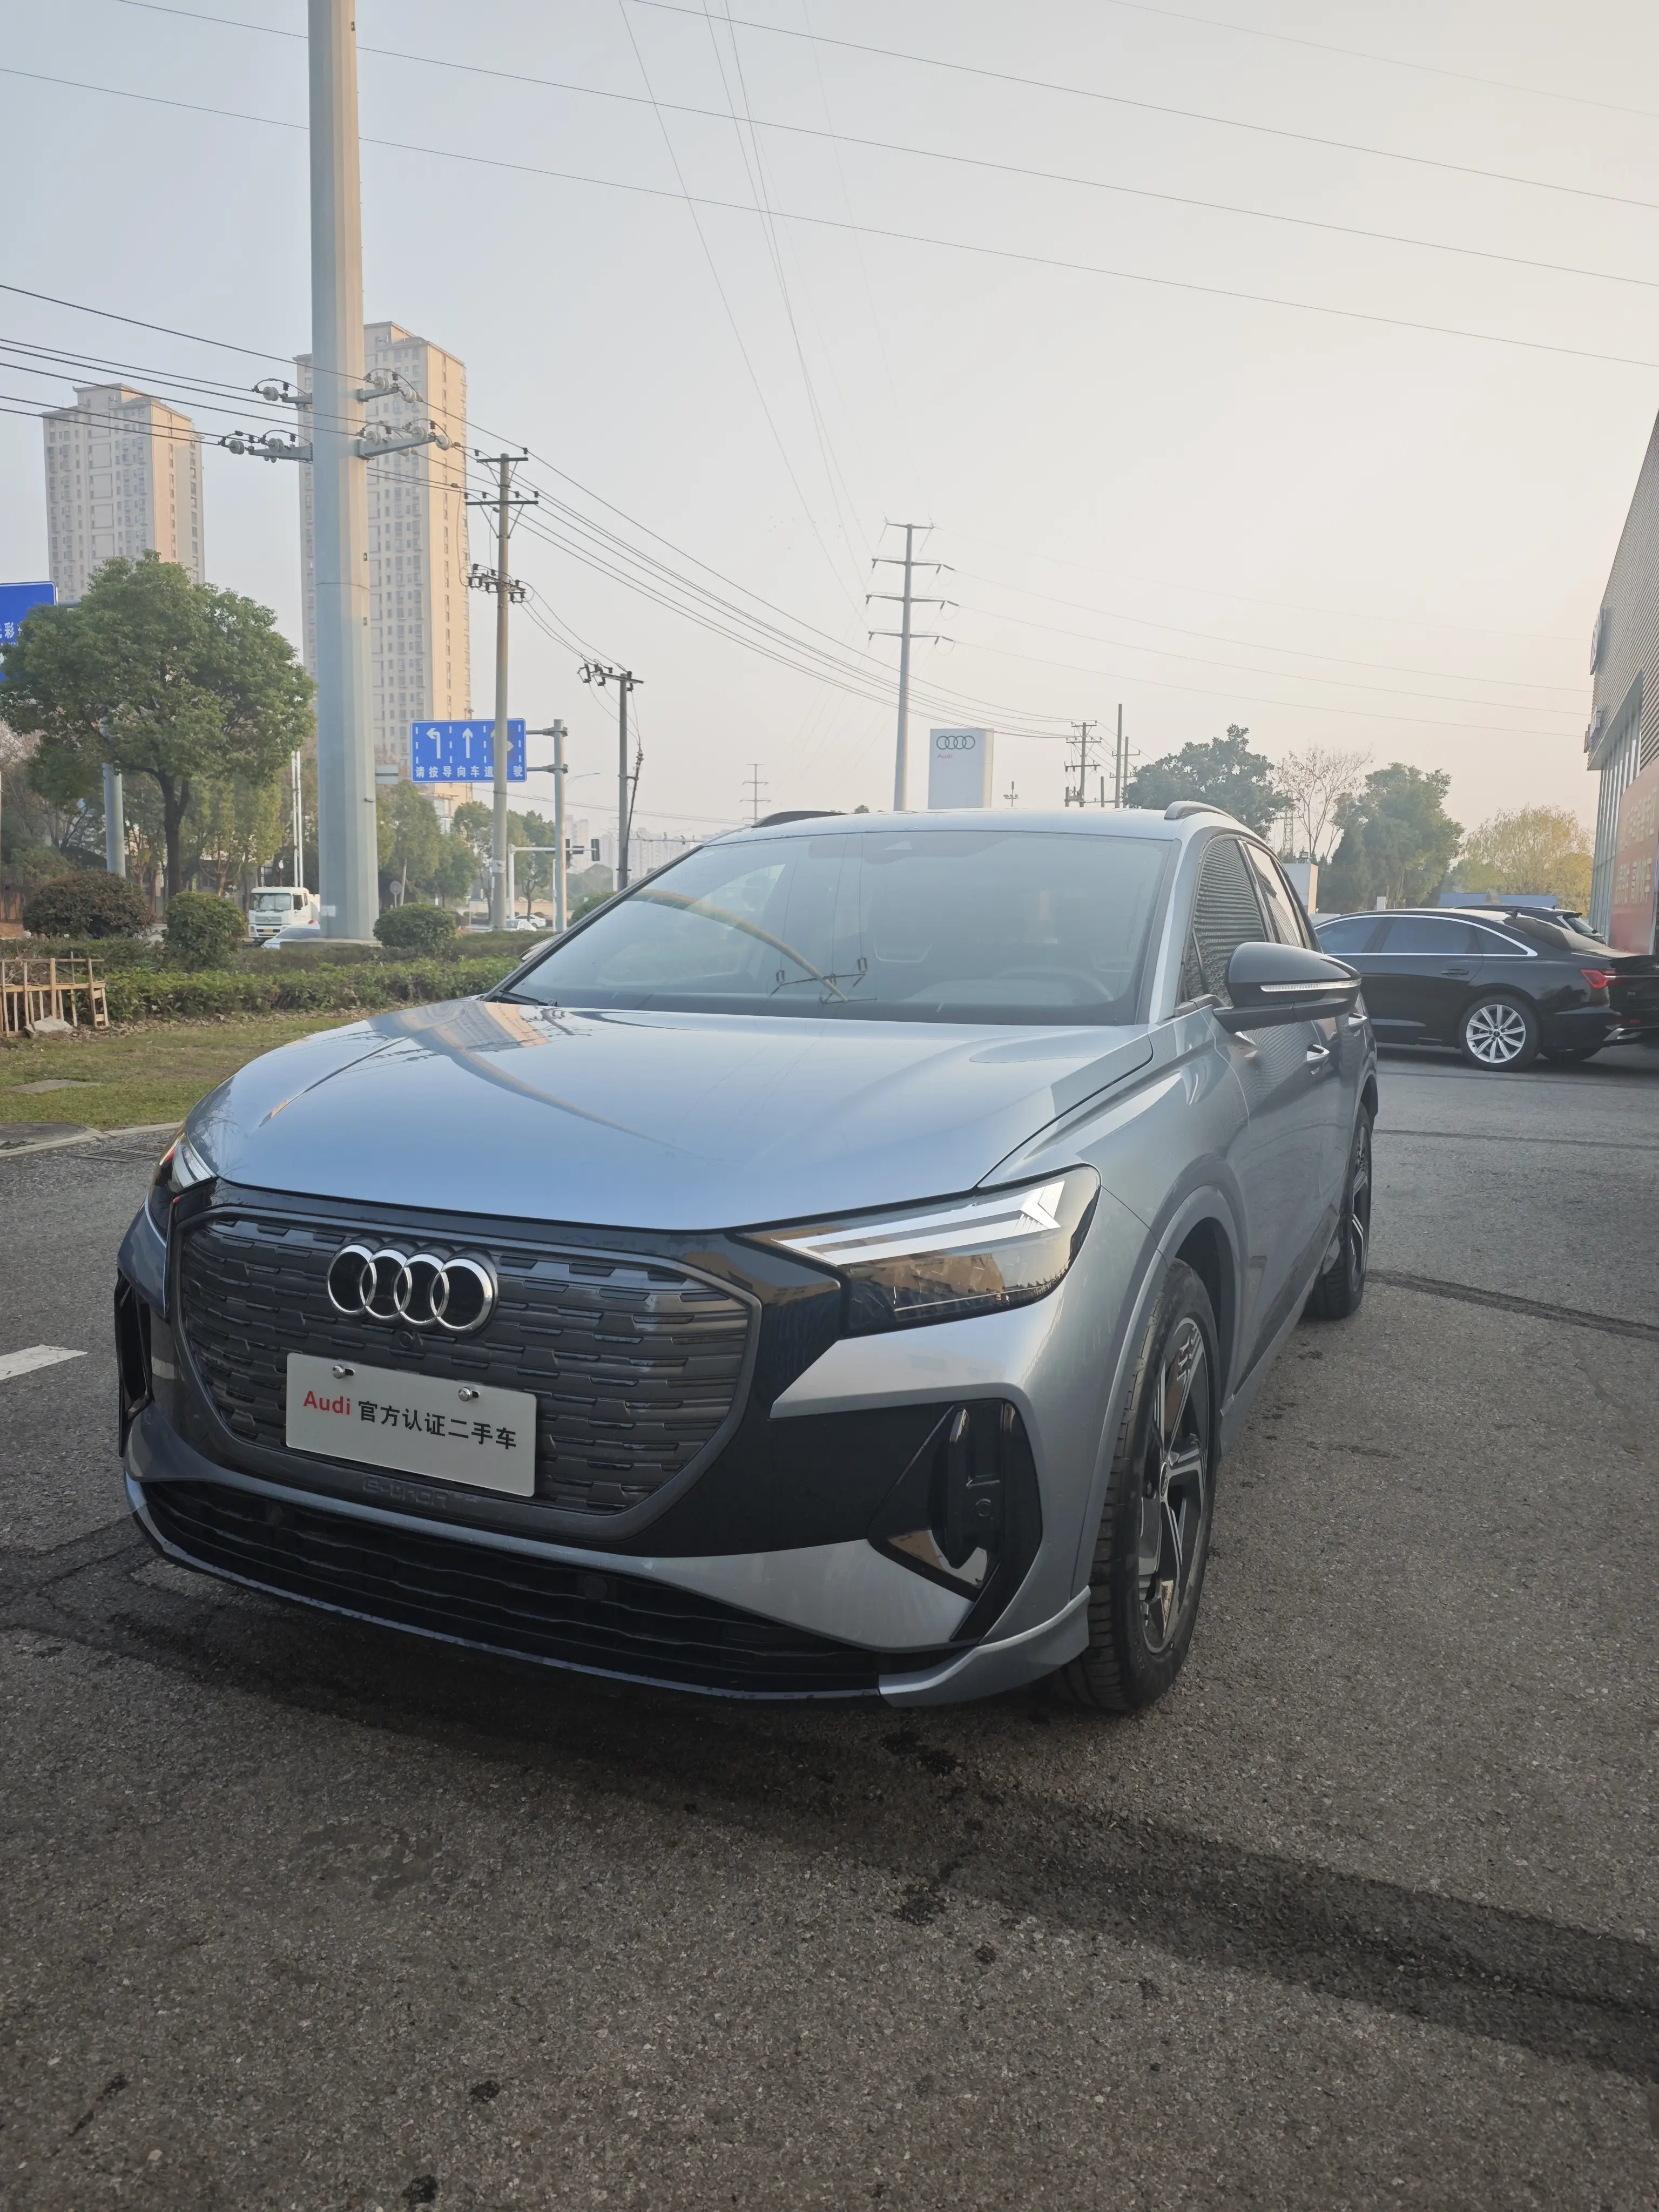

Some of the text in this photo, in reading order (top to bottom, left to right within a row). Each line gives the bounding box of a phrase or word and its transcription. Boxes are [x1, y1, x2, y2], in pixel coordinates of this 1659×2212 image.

[415, 765, 523, 778] 请按导向车道驶
[302, 1391, 517, 1450] Audi 官方认证二手车
